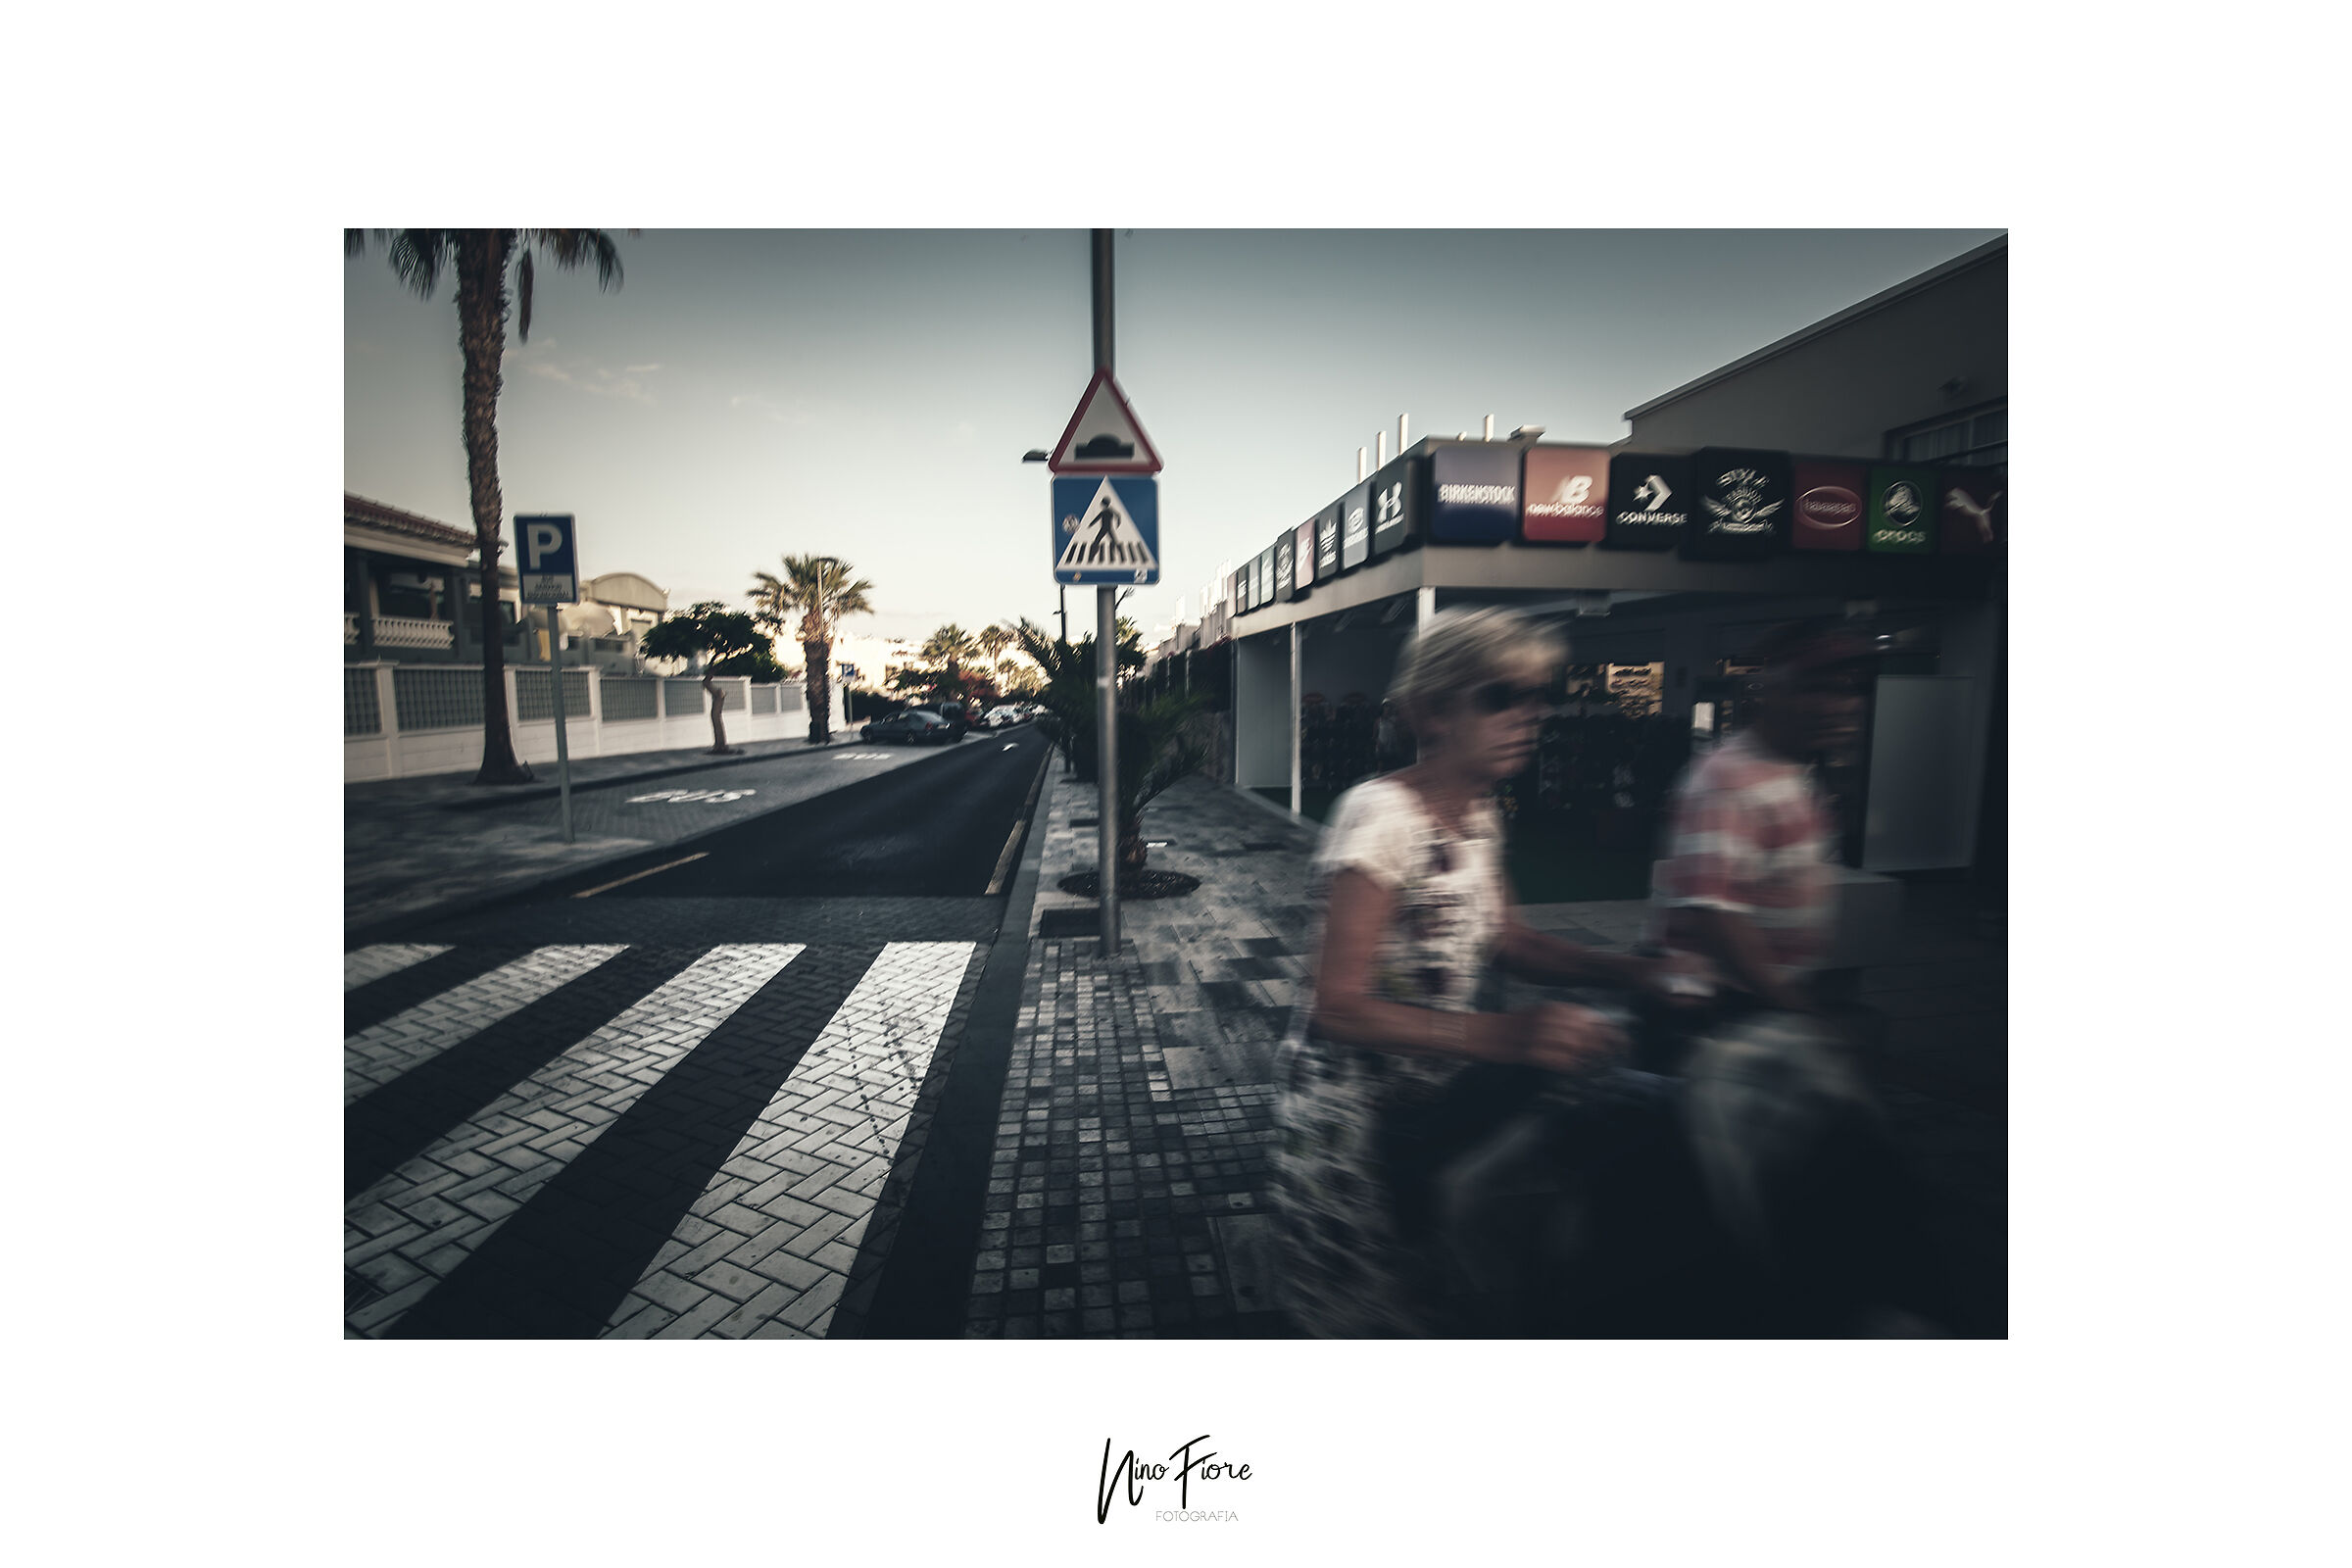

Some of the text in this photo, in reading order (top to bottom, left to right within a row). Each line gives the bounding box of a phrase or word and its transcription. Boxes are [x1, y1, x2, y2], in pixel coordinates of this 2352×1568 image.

[1438, 483, 1515, 505] BIRKENSTOCK
[1616, 511, 1688, 525] CONVERSE
[1873, 529, 1927, 544] crocs
[527, 524, 563, 569] P
